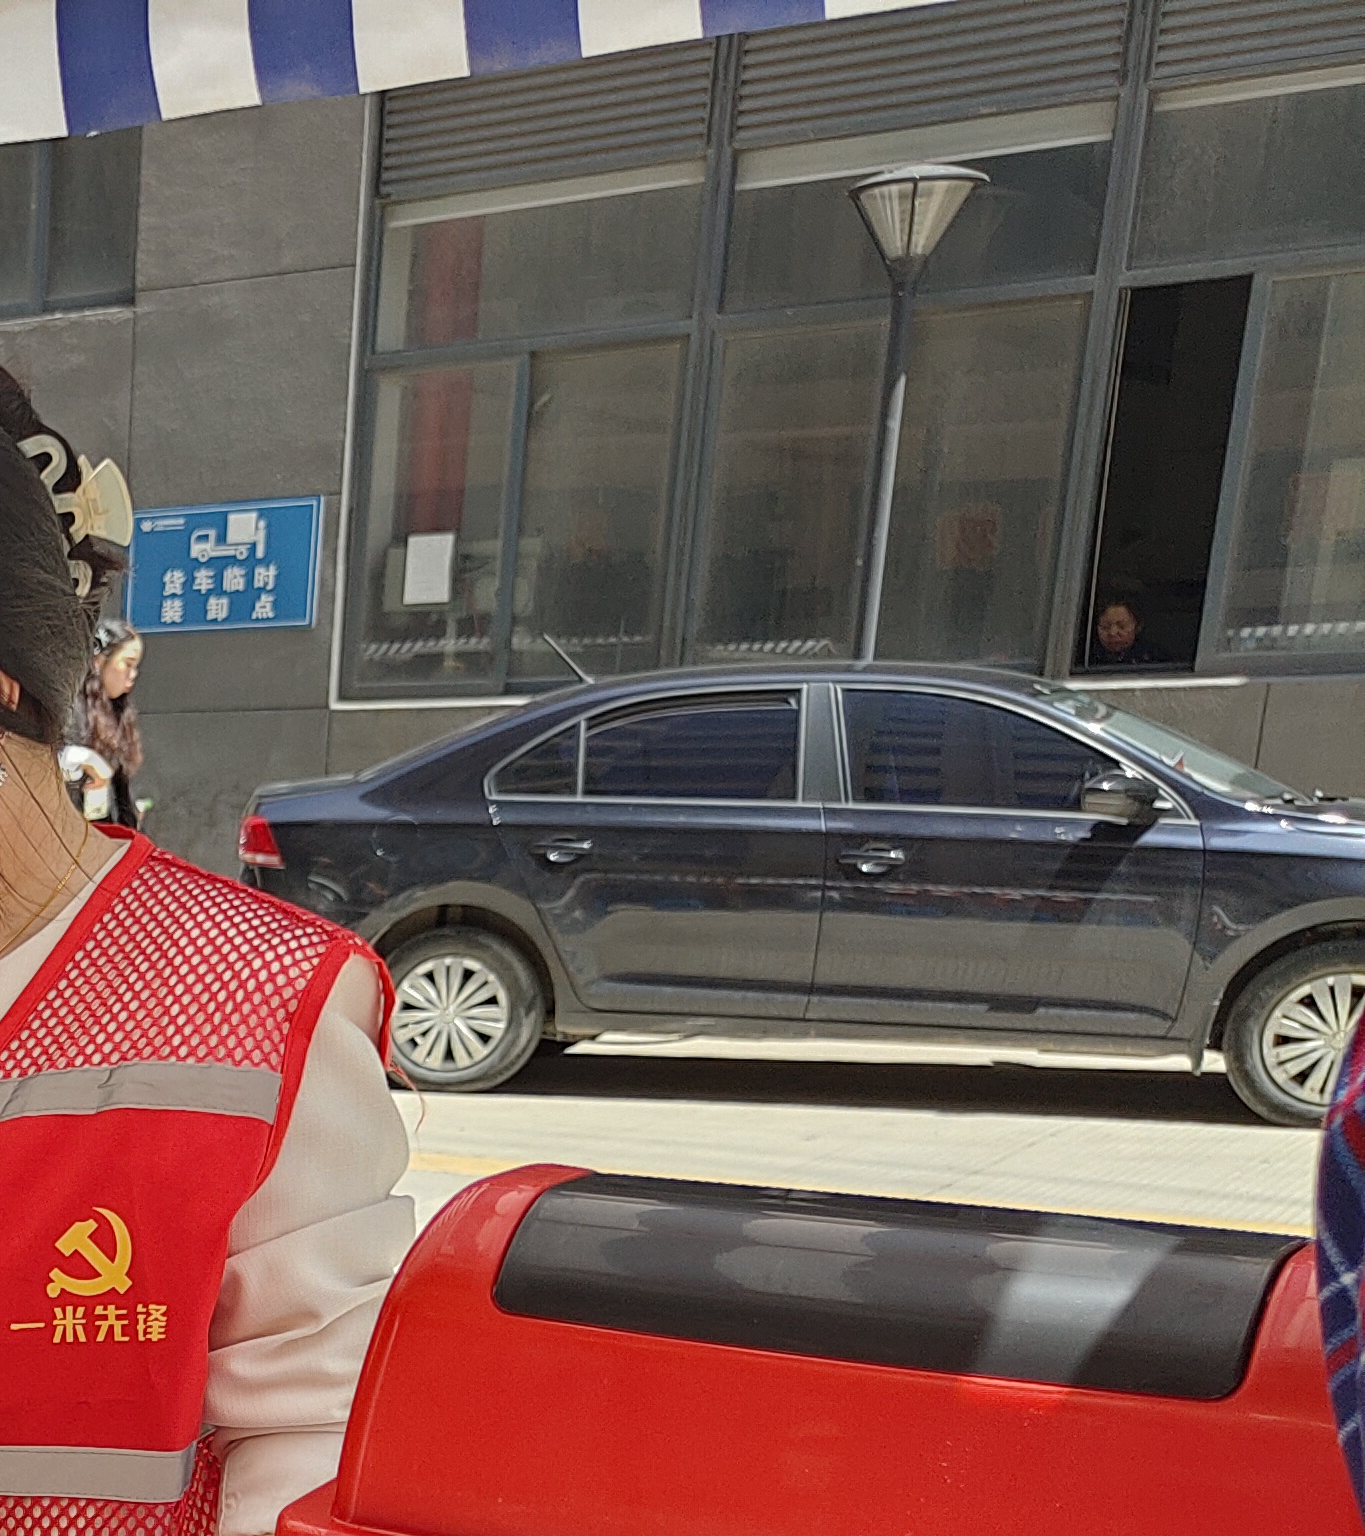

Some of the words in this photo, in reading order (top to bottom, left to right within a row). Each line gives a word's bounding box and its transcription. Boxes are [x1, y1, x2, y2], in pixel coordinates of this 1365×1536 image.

[162, 560, 278, 596] 货车临时
[160, 592, 276, 624] 装卸点
[9, 1301, 170, 1346] 一米先锋
